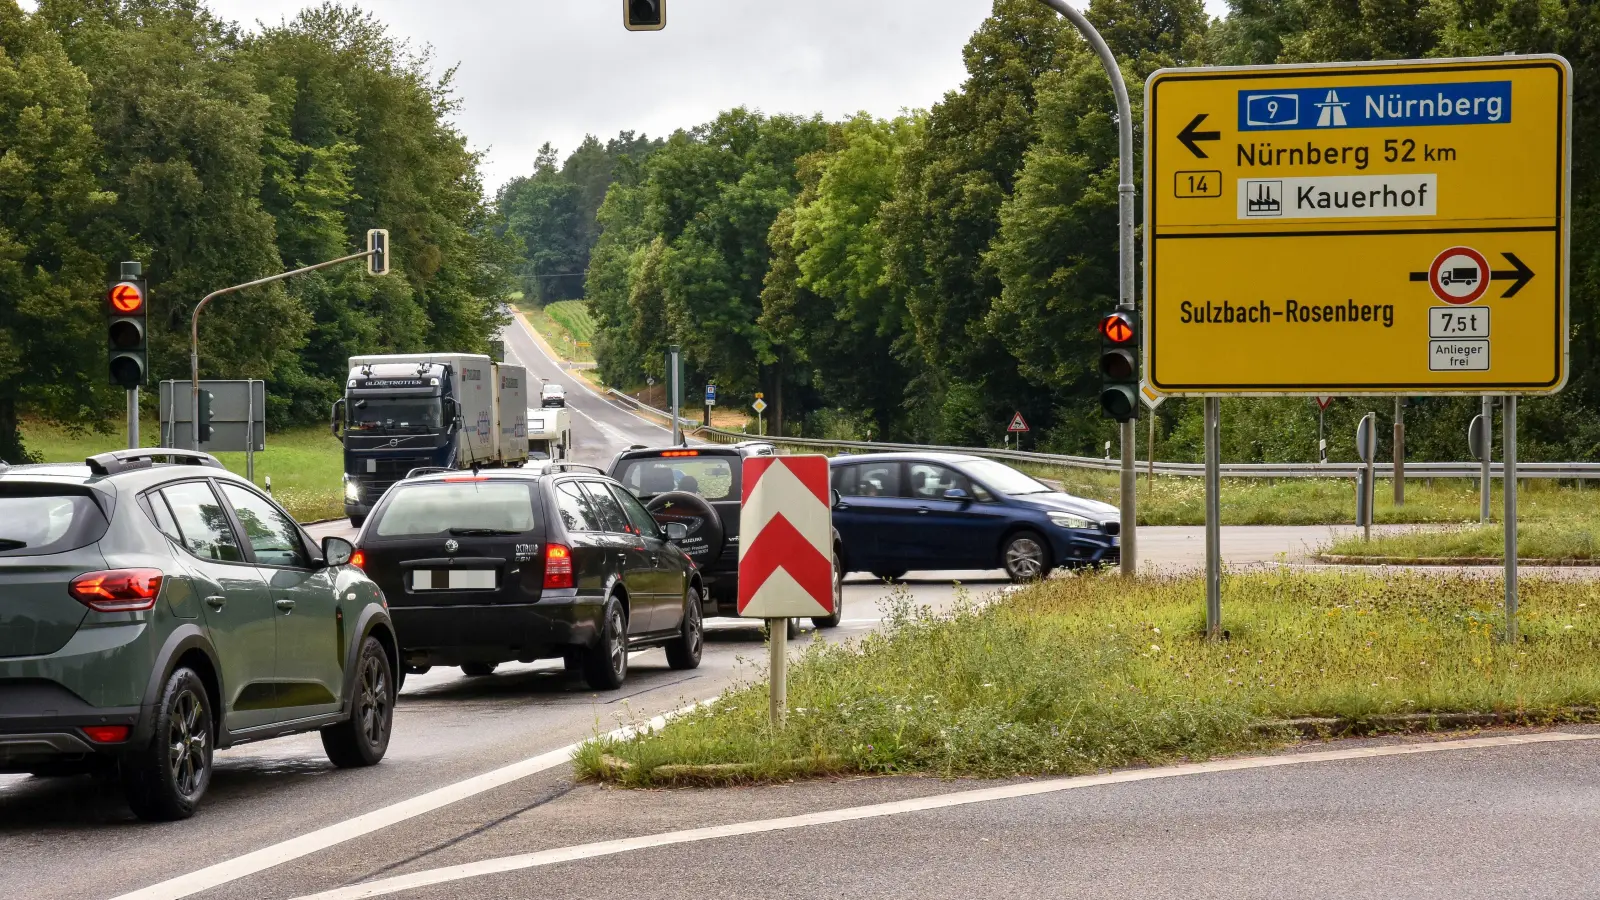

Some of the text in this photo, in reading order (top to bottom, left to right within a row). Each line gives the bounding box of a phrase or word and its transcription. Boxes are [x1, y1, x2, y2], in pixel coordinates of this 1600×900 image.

[1266, 102, 1279, 120] 9
[1365, 93, 1503, 121] Nürnberg
[1237, 139, 1457, 170] Nürnberg 52 km
[1188, 176, 1208, 194] 14
[1297, 183, 1428, 210] Kauerhof
[1180, 299, 1394, 328] Sulzbach-Rosenberg
[1441, 313, 1477, 333] 7,5 t
[1436, 344, 1483, 356] Anlieger
[1450, 357, 1469, 366] frei
